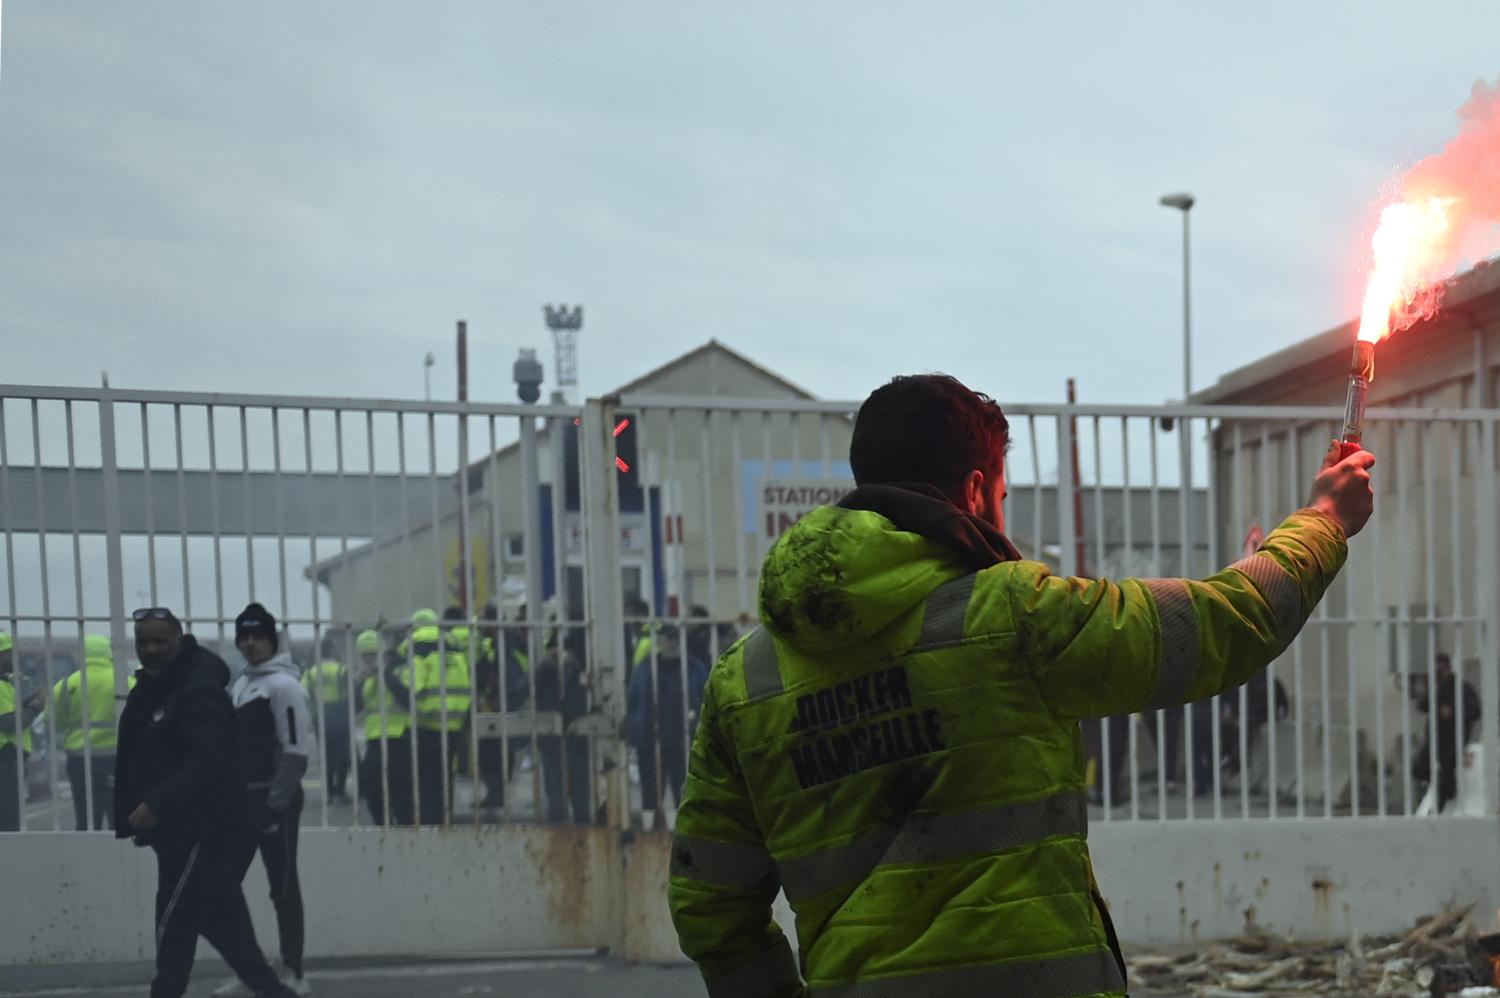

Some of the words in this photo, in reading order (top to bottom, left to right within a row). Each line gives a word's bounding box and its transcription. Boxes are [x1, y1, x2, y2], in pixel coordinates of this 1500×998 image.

[764, 485, 850, 506] STATION
[790, 665, 912, 733] DOCKER
[790, 708, 946, 790] MARSEILLE
